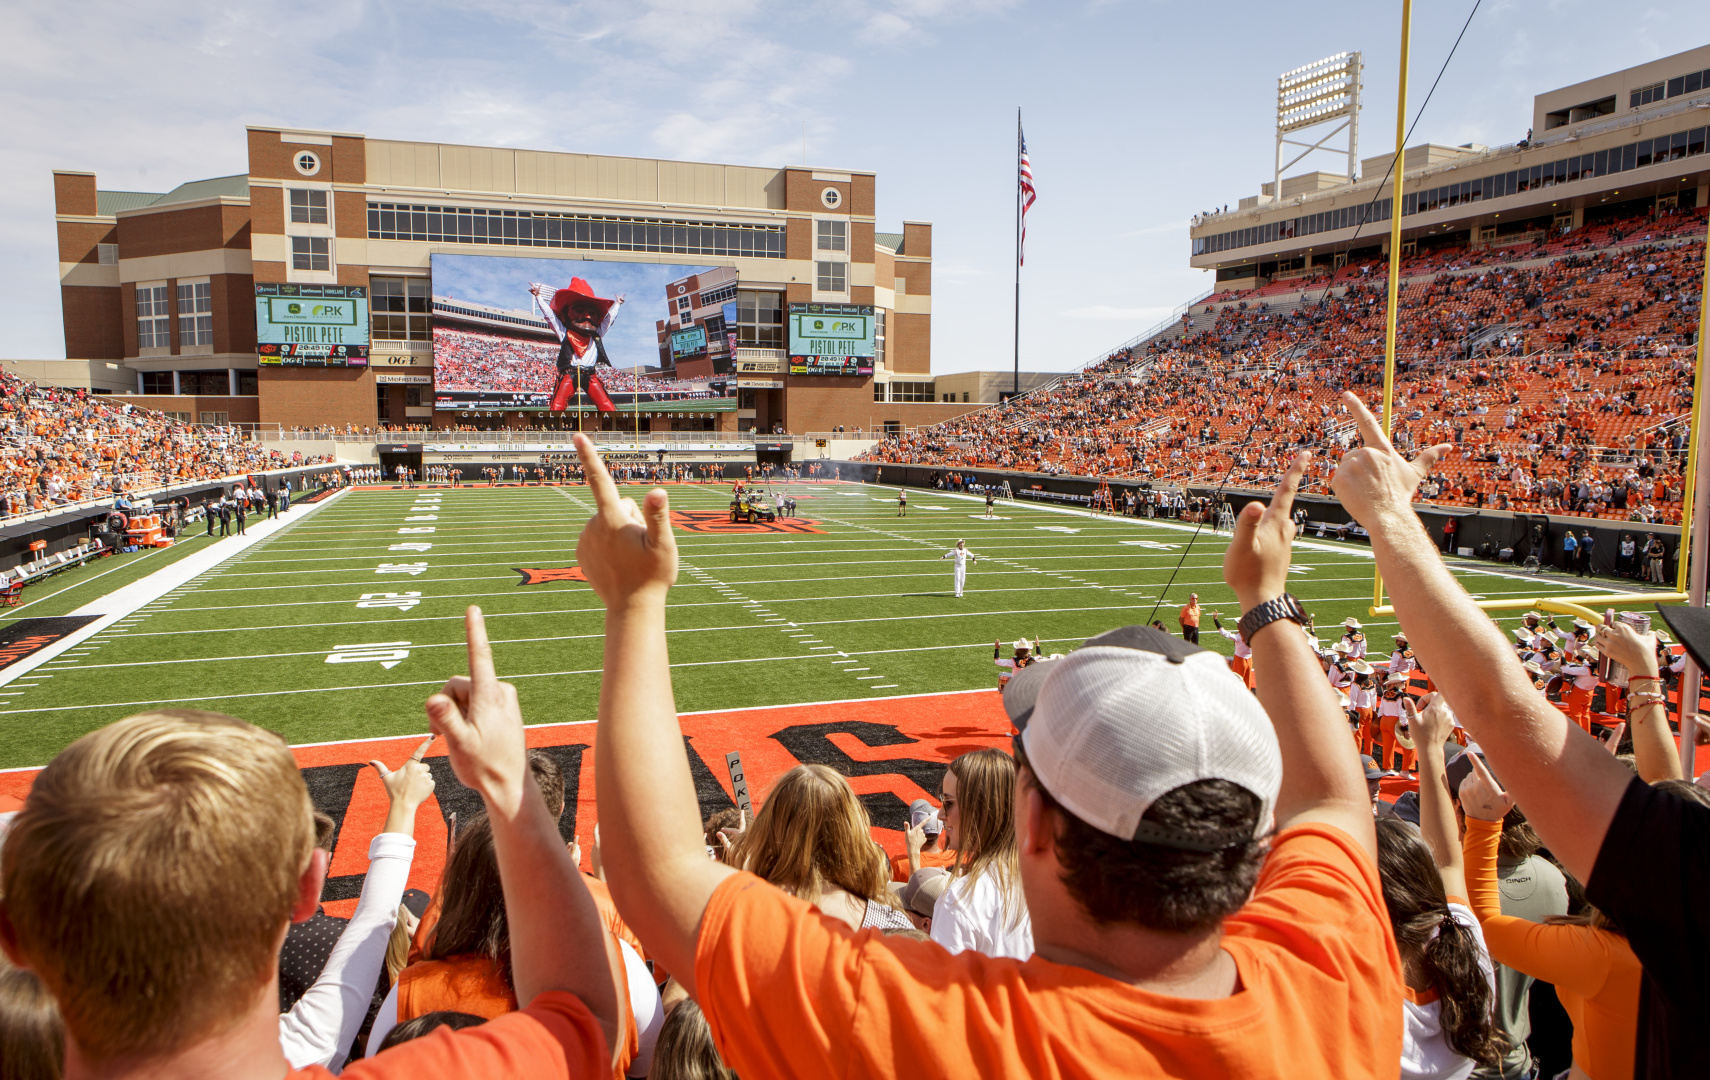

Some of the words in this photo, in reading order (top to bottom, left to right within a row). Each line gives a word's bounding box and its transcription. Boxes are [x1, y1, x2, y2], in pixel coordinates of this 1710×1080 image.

[284, 326, 318, 342] PISTOL
[321, 327, 344, 343] PETE
[810, 340, 836, 354] PISTOL
[838, 341, 856, 355] PETE
[816, 439, 826, 447] 25
[1505, 876, 1532, 884] CINCH
